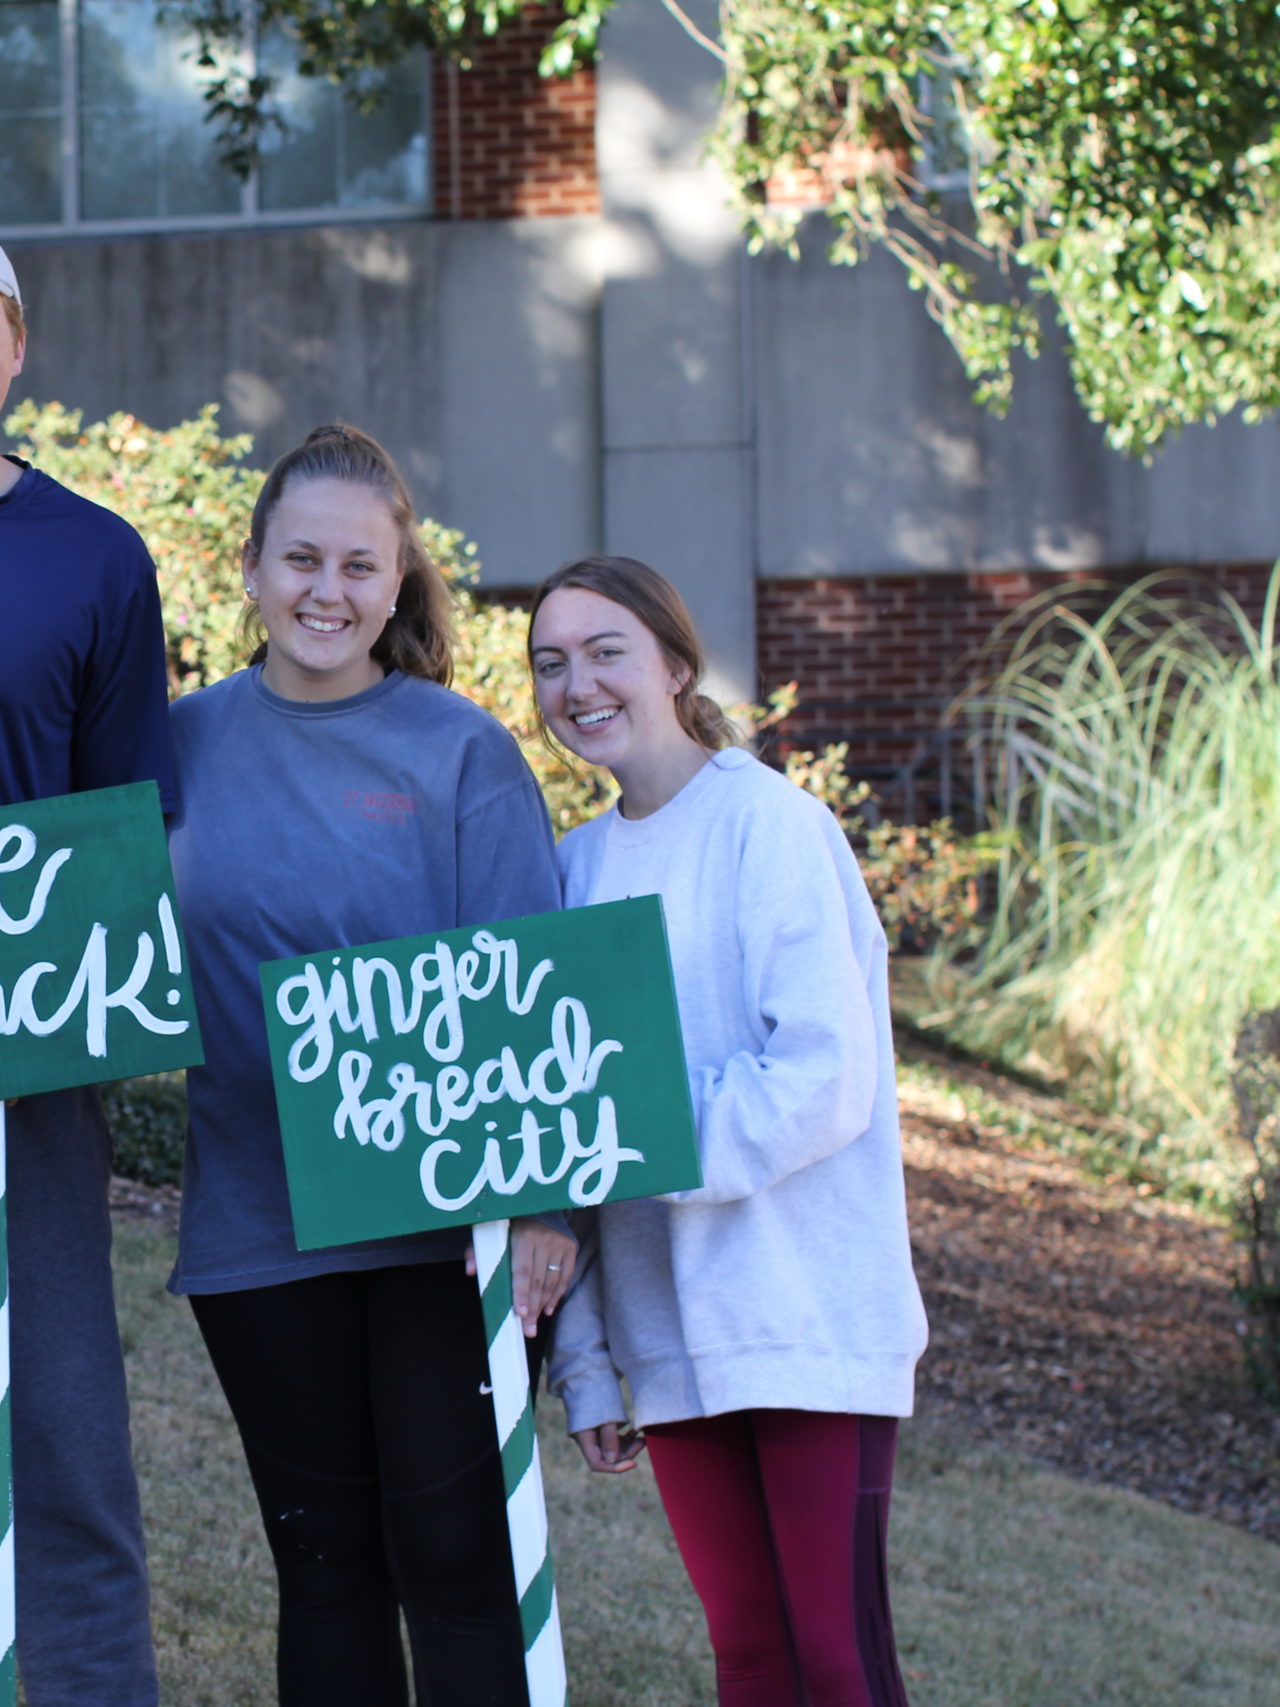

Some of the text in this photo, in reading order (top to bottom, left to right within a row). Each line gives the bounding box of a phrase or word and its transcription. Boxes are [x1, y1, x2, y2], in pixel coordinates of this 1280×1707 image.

[276, 930, 554, 1083] ginger
[333, 996, 624, 1151] bread
[420, 1095, 645, 1211] city
